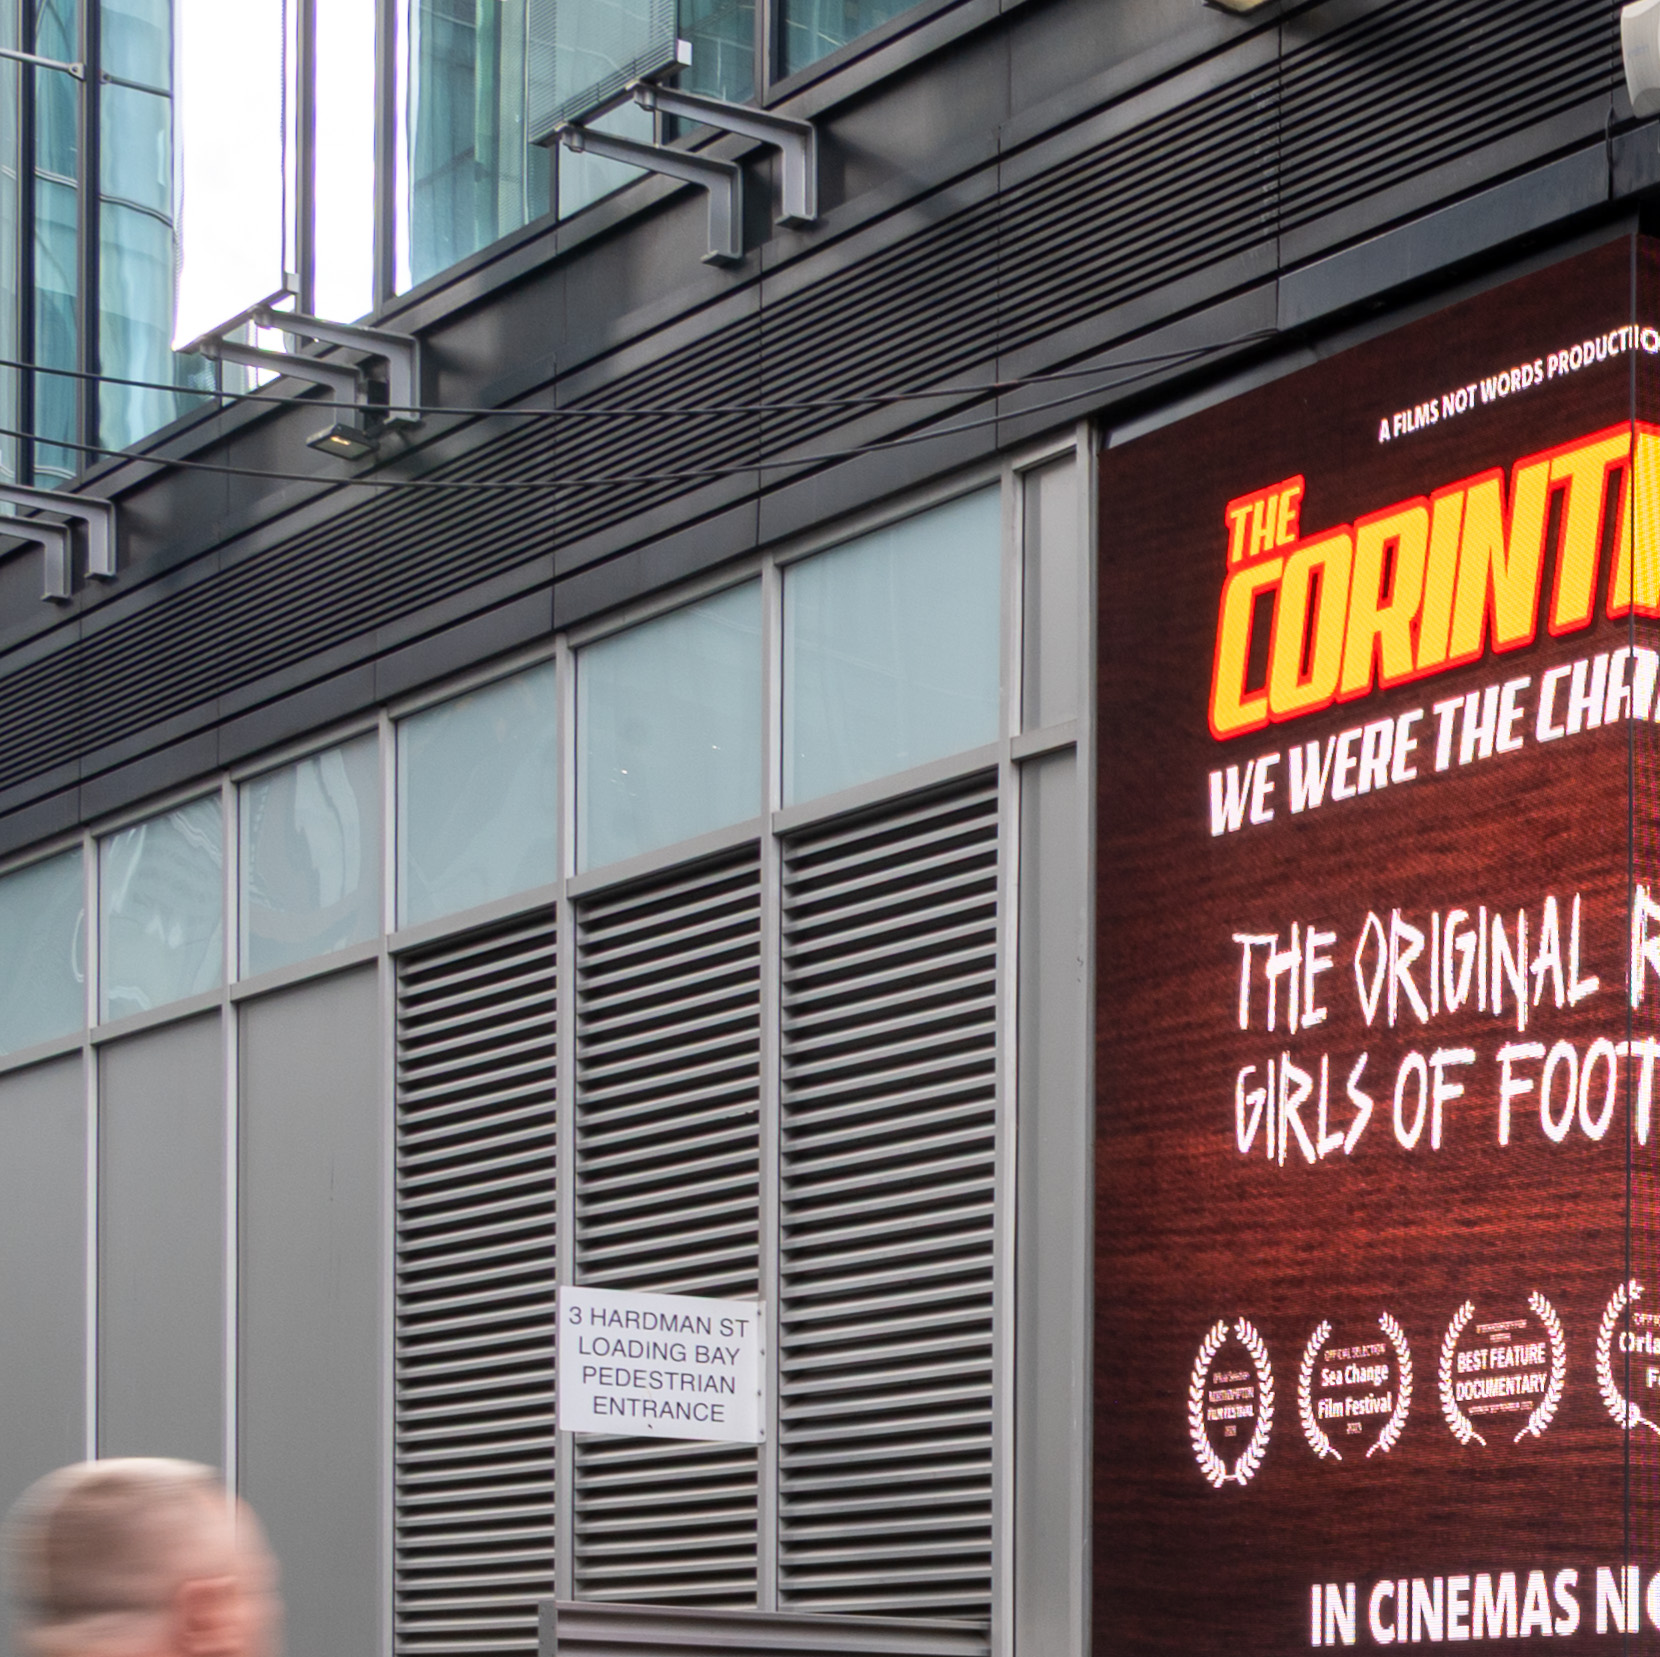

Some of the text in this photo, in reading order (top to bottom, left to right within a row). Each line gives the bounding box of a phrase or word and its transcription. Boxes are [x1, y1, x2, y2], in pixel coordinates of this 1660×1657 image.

[1378, 417, 1391, 443] A
[1393, 399, 1440, 438] FILMS
[1441, 383, 1478, 420] NOT
[1480, 358, 1544, 405] WORDS
[1227, 479, 1303, 566] THE
[1209, 753, 1280, 837] WE
[1288, 709, 1424, 814] WERE
[1433, 676, 1531, 772] THE
[1232, 921, 1336, 1034] THE
[1354, 892, 1599, 1032] ORIGINAL
[1235, 1050, 1373, 1167] GIRLS
[1393, 1047, 1476, 1151] OF
[568, 1306, 749, 1338] 3 HARDMAN ST
[578, 1336, 740, 1365] LOADING BAY
[1457, 1342, 1546, 1374] BEST FEATURE
[582, 1366, 735, 1394] PEDESTRIAN
[1321, 1362, 1389, 1387] Sea Change
[1456, 1371, 1547, 1401] DOCUMENTARY
[593, 1396, 725, 1422] ENTRANCE
[1317, 1391, 1392, 1419] Film Festival
[1311, 1582, 1356, 1647] IN
[1368, 1569, 1580, 1645] CINEMAS
